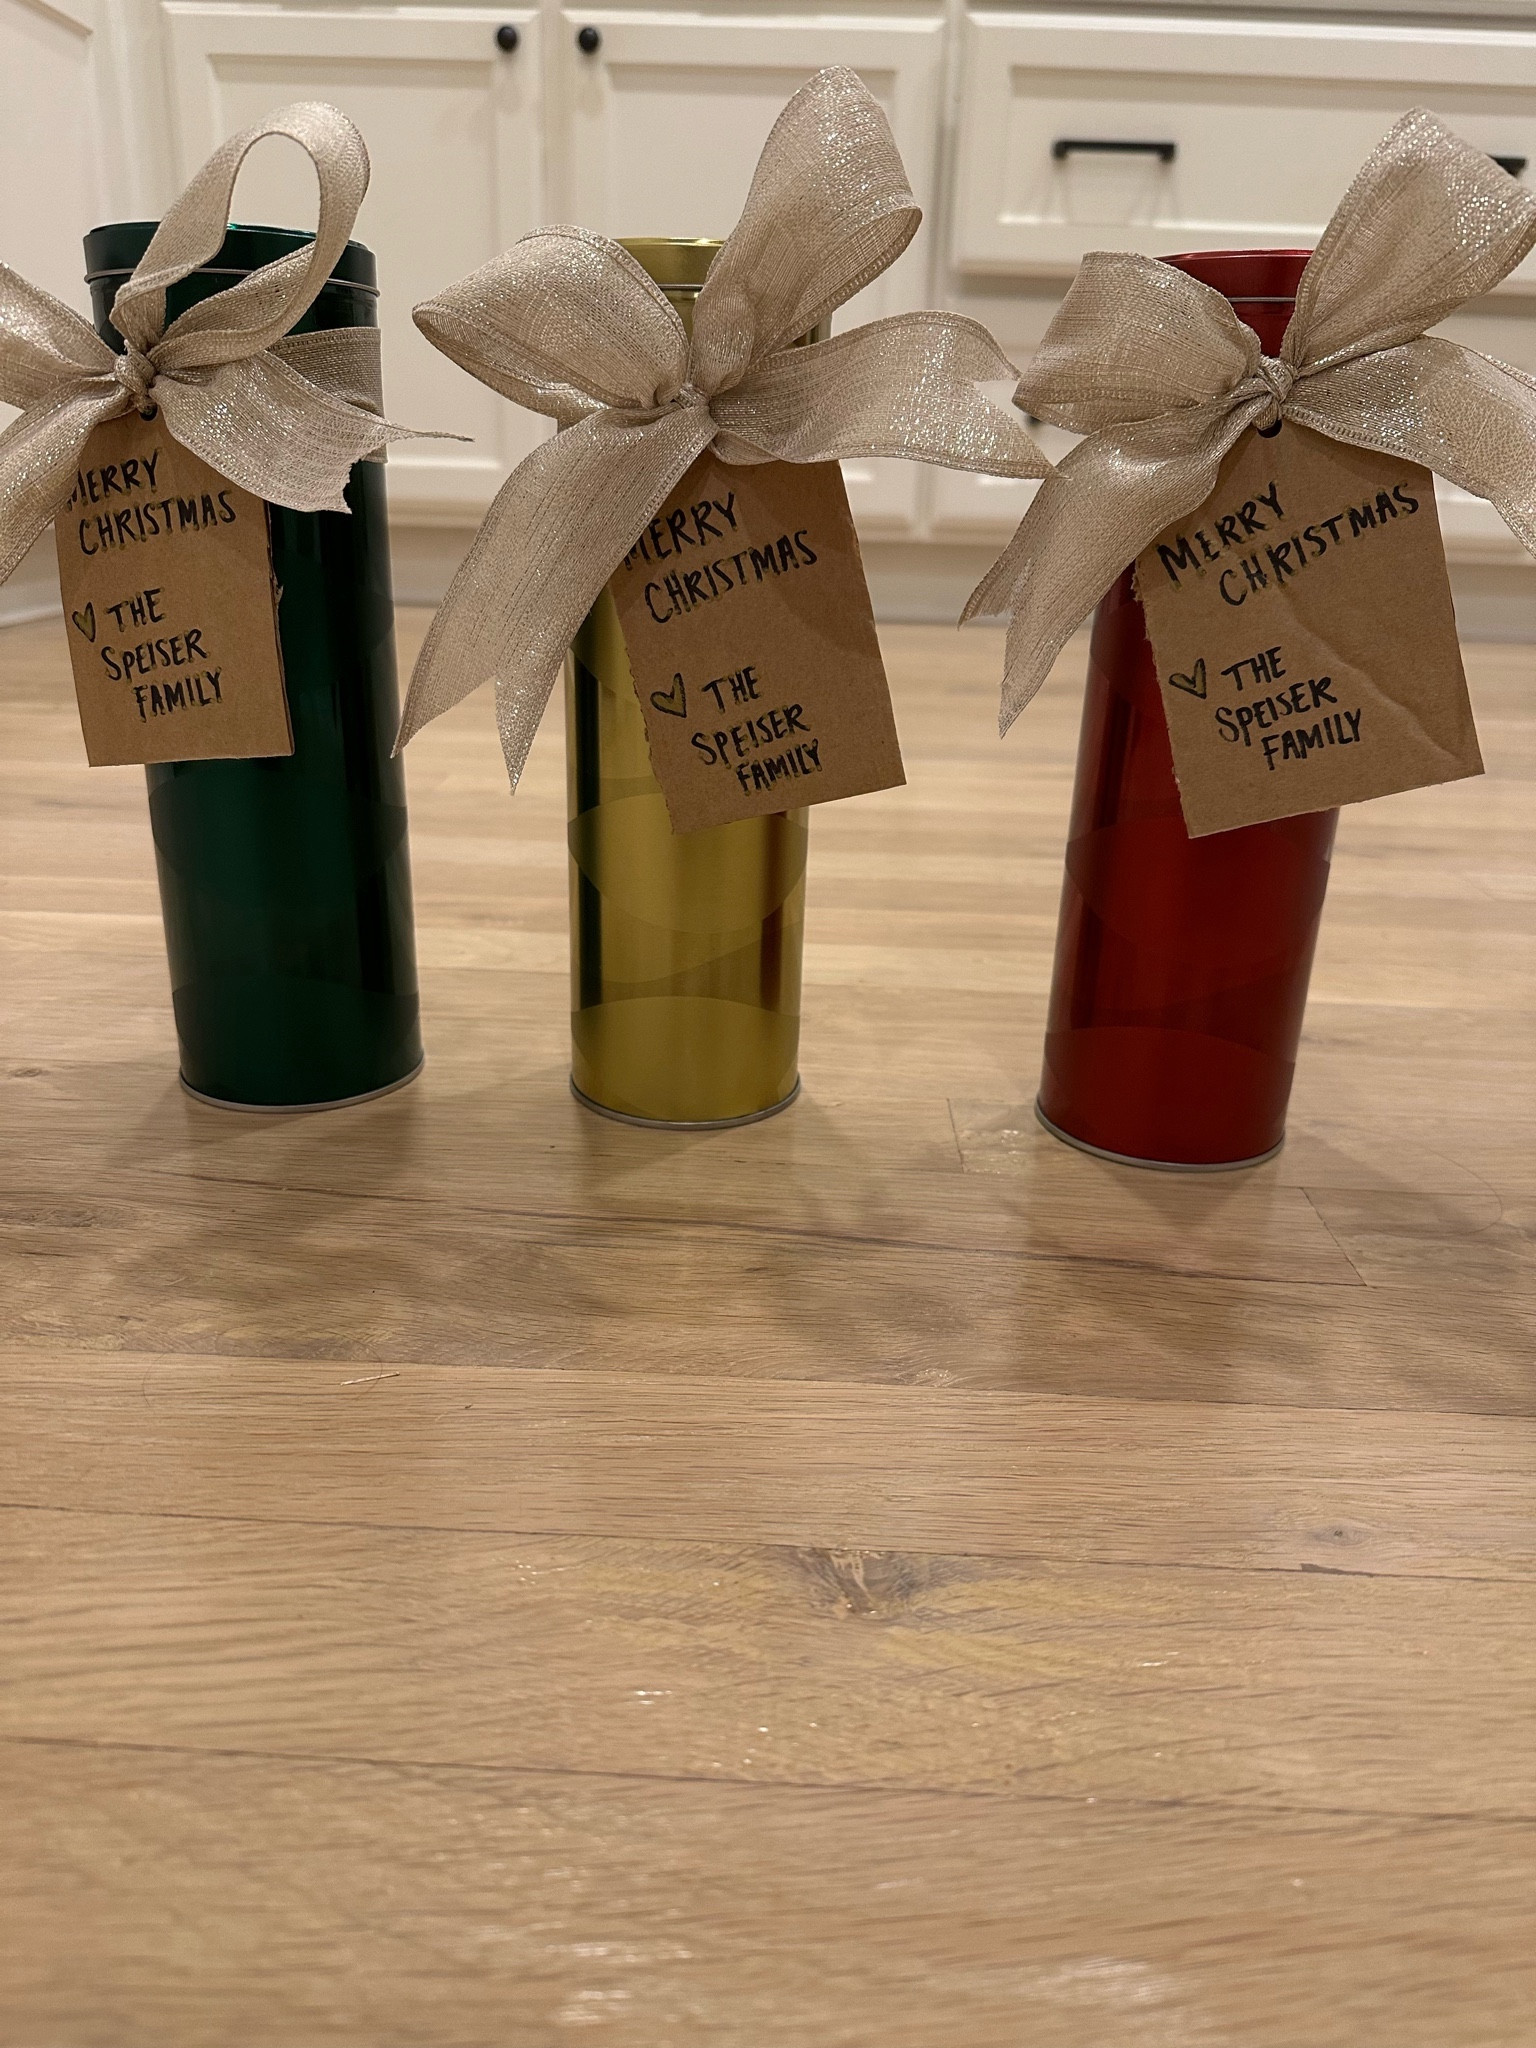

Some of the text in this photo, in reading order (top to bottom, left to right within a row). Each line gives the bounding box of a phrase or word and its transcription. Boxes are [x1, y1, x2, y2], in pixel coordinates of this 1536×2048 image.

[78, 490, 236, 555] CHRISTMAS
[1155, 480, 1287, 591] MERRY
[1218, 481, 1420, 606] CHRISTMAS
[644, 529, 818, 624] CHRISTMAS
[104, 587, 165, 632] THE
[101, 628, 210, 683] SPEISER
[1221, 646, 1287, 691] THE
[132, 666, 223, 723] FAMILY
[701, 665, 763, 714] THE
[1214, 676, 1338, 747] SPEISER
[691, 702, 812, 769] SPEISER
[736, 738, 823, 796] FAMILY
[1261, 708, 1362, 771] FAMILY
